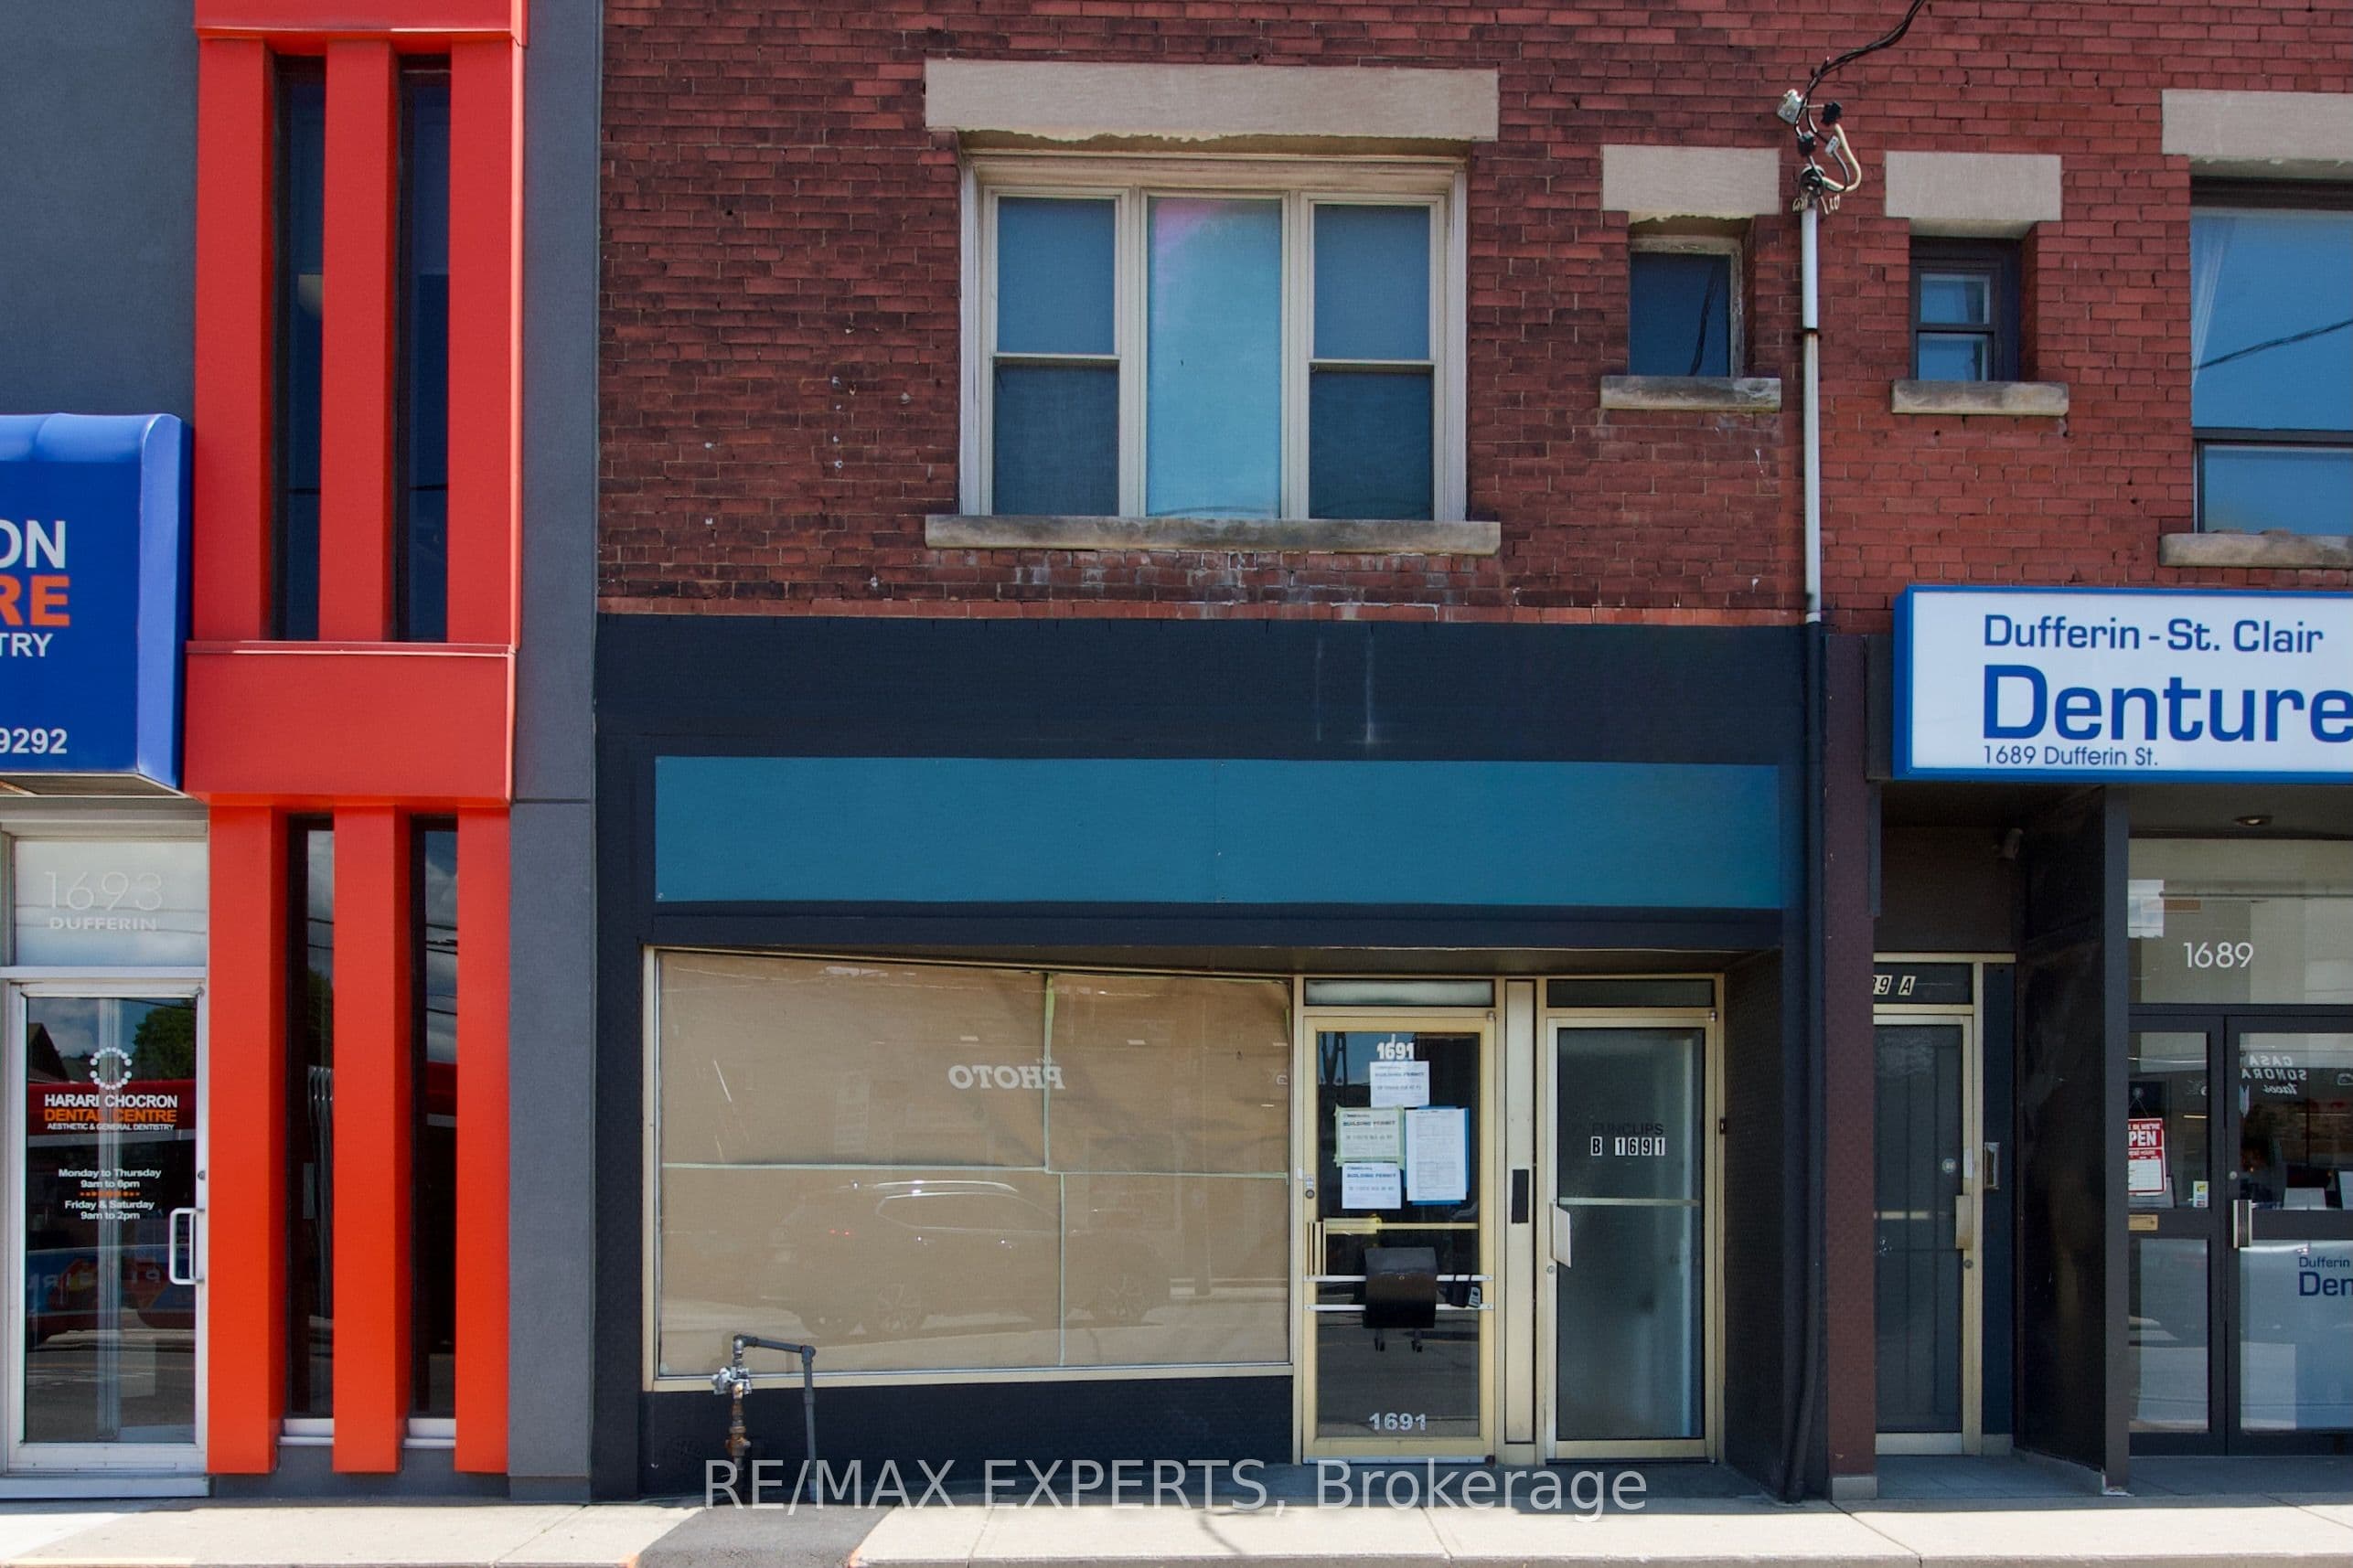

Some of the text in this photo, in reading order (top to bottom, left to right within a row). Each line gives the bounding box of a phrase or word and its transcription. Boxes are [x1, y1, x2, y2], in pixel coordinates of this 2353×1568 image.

[1984, 613, 2141, 650] Dufferin
[2166, 618, 2221, 652] St.
[2233, 619, 2325, 654] Clair
[1983, 664, 2353, 743] Denture
[1984, 745, 2159, 767] 1689 Dufferin St.
[44, 871, 163, 912] 1693
[49, 916, 157, 931] DUFFERIN
[2183, 942, 2254, 968] 1689
[1874, 976, 1911, 994] 9 A
[1376, 1041, 1415, 1061] 1691
[44, 1093, 178, 1108] HARARI CHOCRON
[44, 1108, 177, 1123] DENTAL CENTRE
[47, 1123, 89, 1131] AESTHETIC
[96, 1123, 133, 1131] GENERAL
[1592, 1137, 1663, 1155] B 1691
[2128, 1130, 2157, 1147] PEN
[59, 1168, 161, 1179] Monday to Thursday
[80, 1179, 102, 1189] 9am
[65, 1200, 155, 1211] Friday & Saturday
[80, 1211, 140, 1221] 9am to 2pm
[2298, 1256, 2350, 1268] Dufferin
[1369, 1413, 1427, 1431] 1691
